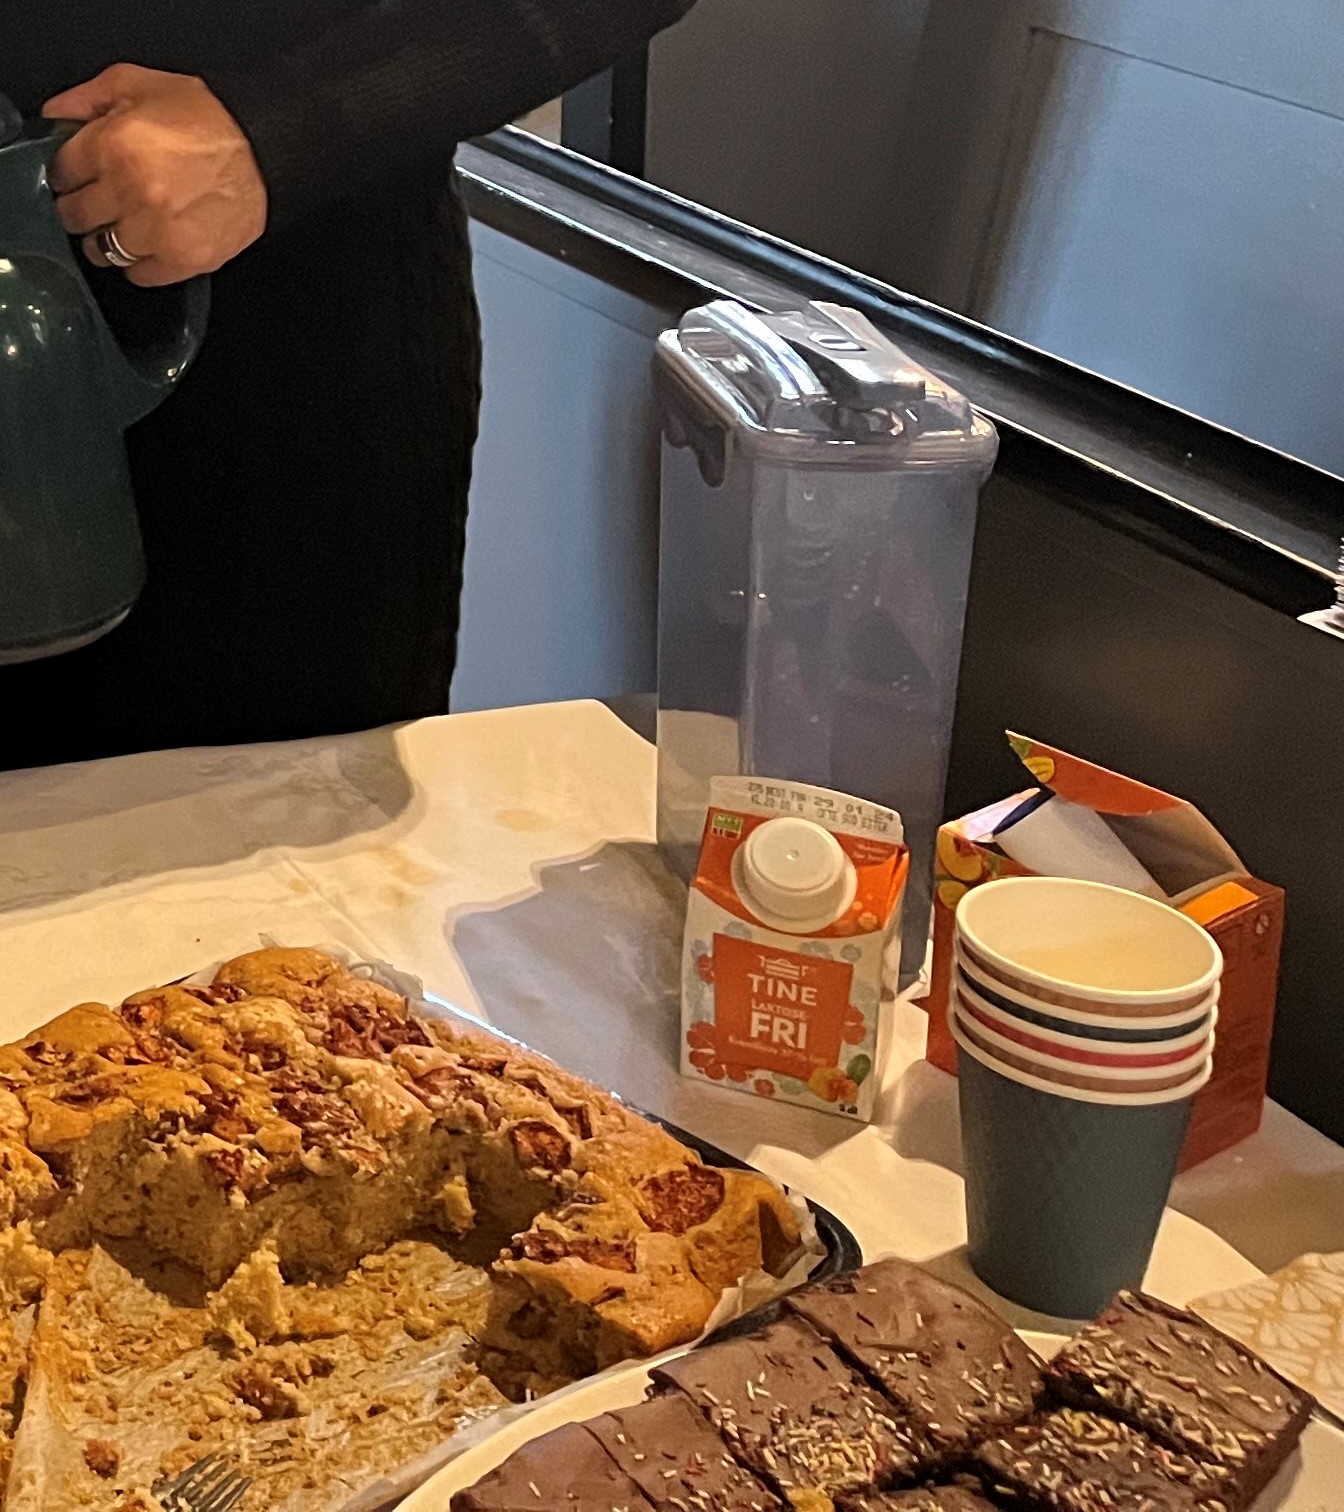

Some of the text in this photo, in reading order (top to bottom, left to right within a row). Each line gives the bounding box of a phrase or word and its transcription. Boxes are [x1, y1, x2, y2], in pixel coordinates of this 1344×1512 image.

[814, 796, 833, 808] 29
[845, 803, 862, 815] 01
[874, 809, 894, 822] 24
[747, 973, 817, 1006] TINE
[751, 998, 806, 1020] LAKTOSE
[750, 1011, 807, 1049] FRI
